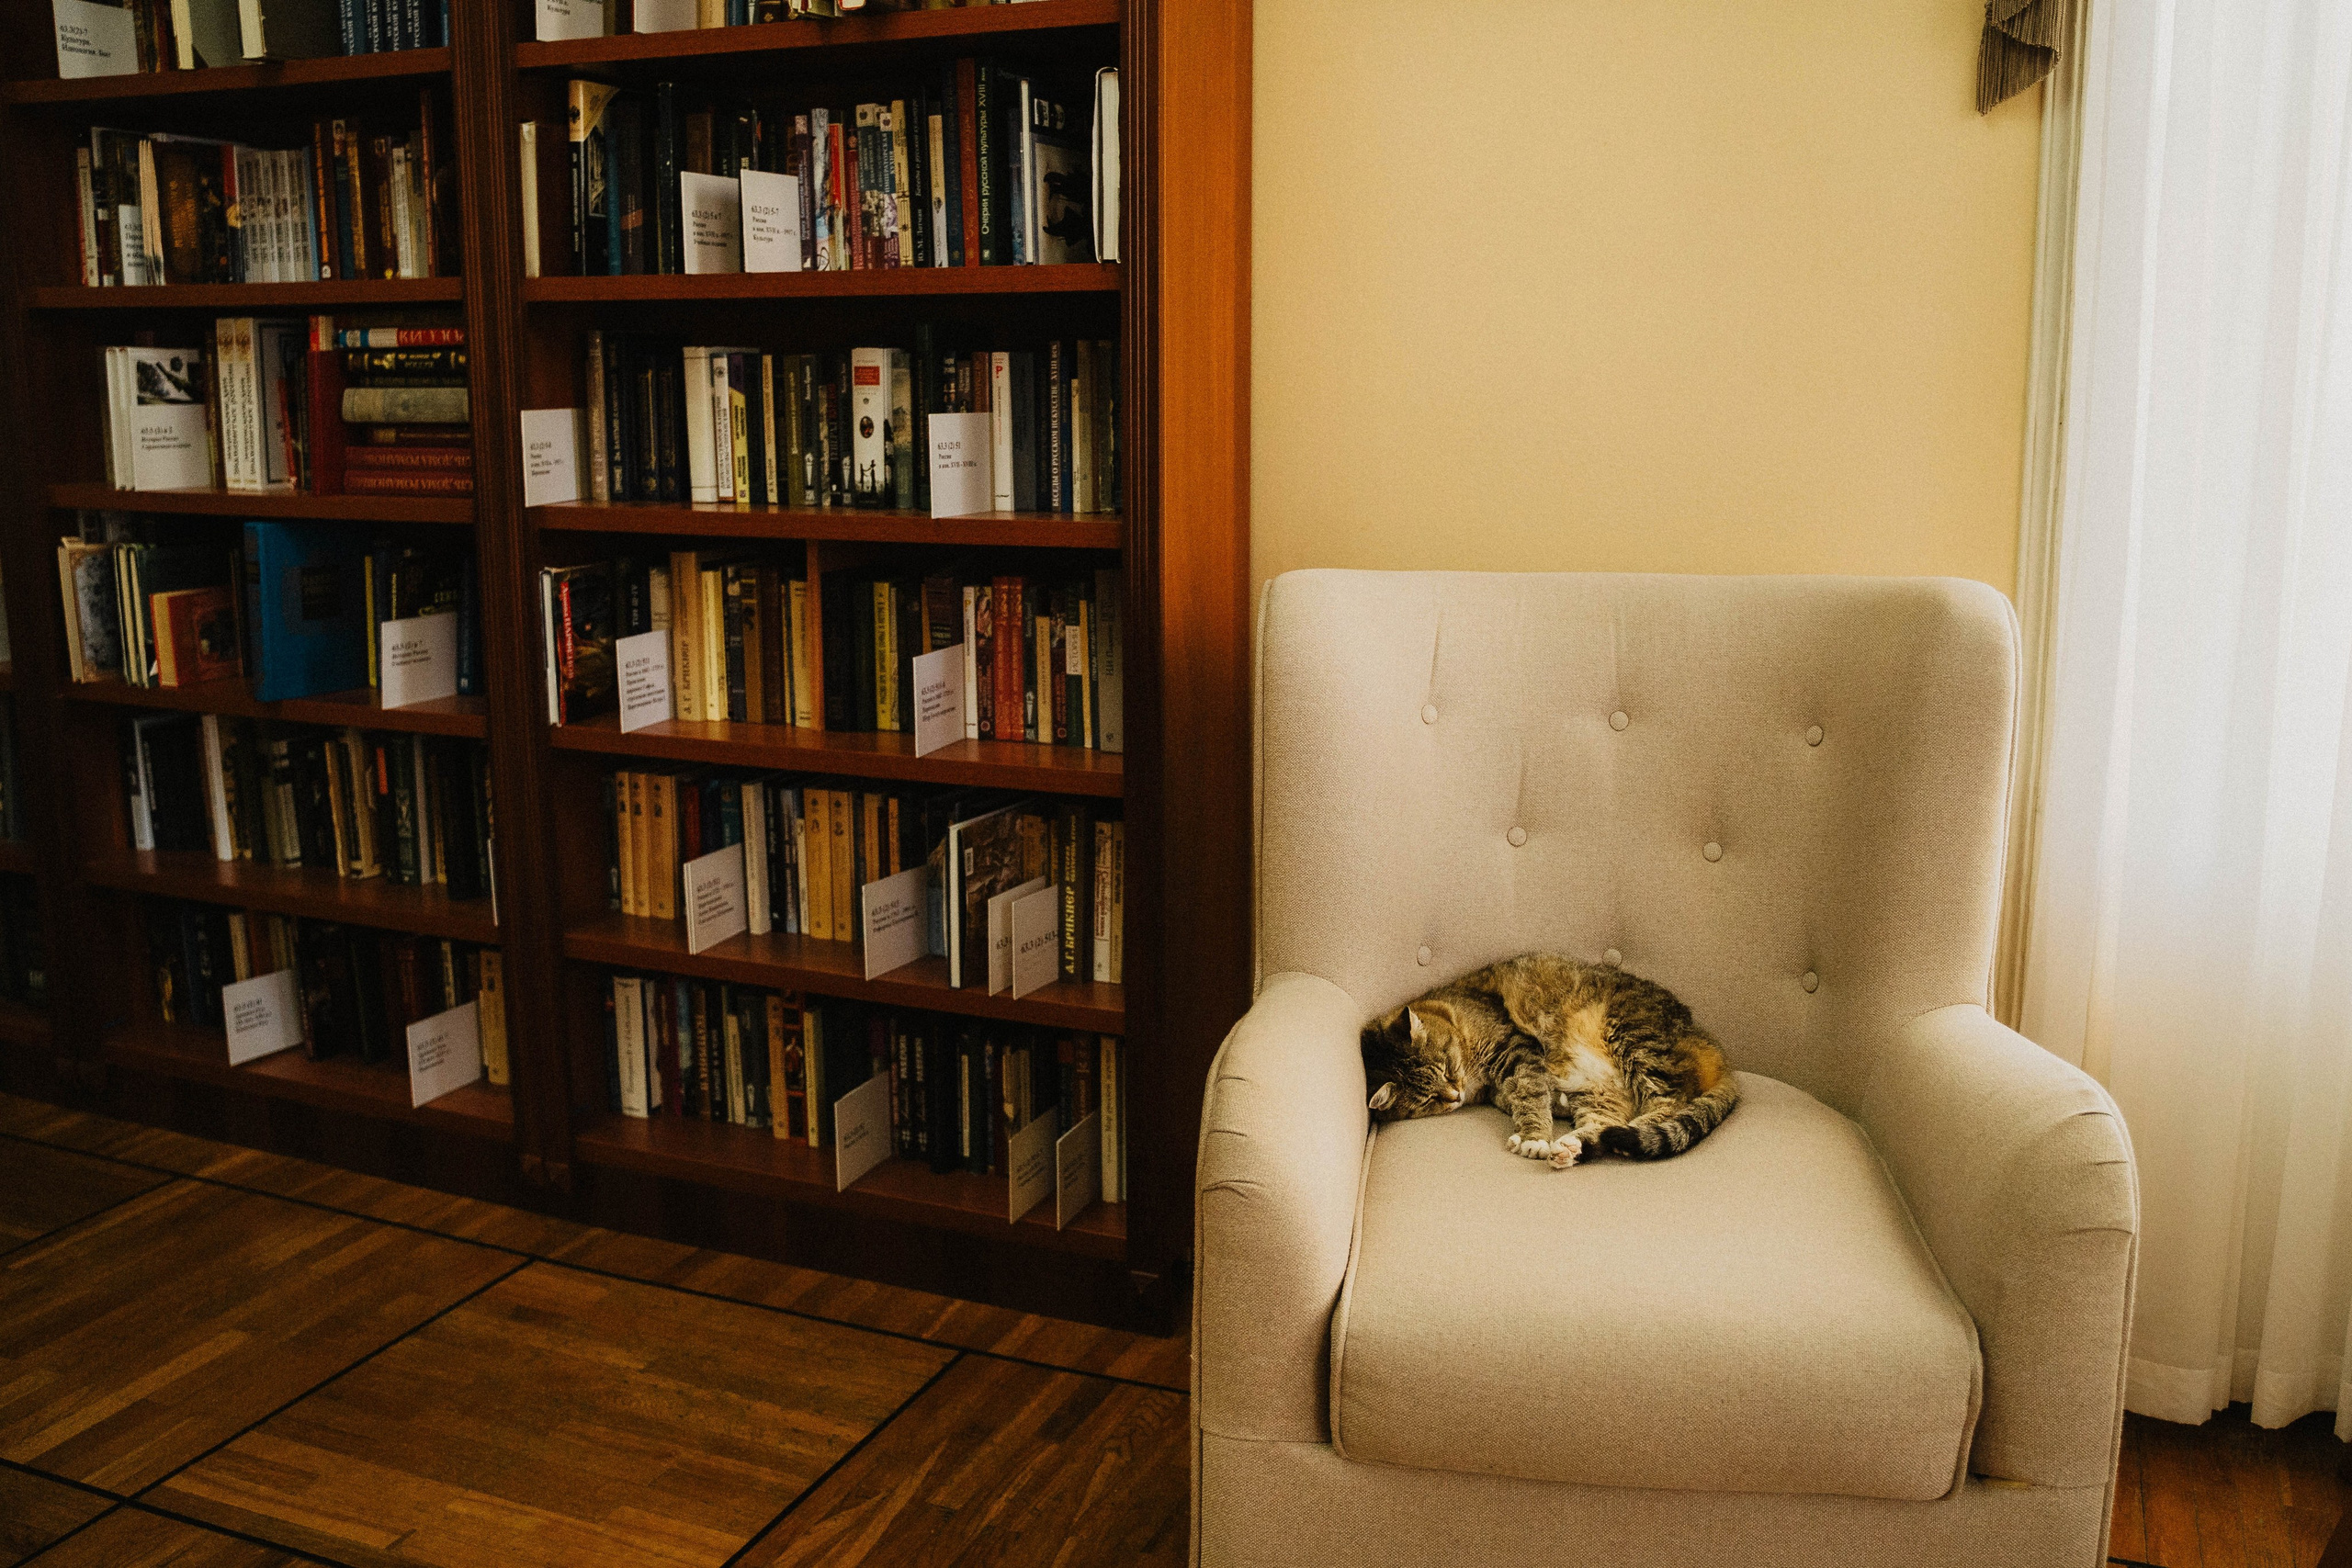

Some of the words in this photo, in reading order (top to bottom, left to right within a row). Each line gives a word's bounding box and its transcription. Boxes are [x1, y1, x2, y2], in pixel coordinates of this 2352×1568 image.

[371, 15, 379, 53] РУССКОЙ
[391, 13, 400, 51] РУССКОЙ
[978, 83, 986, 107] XVIII
[979, 109, 989, 154] культуры
[914, 169, 922, 197] Беседы
[980, 156, 989, 197] русской
[981, 197, 989, 235] Очерки
[1049, 358, 1057, 380] XVIII
[1049, 385, 1058, 429] ИСКУССТВЕ
[1050, 431, 1058, 467] РУССКОМ
[1050, 475, 1059, 507] БЕСЕДЫ
[681, 639, 691, 691] БРИКНЕР
[1020, 942, 1034, 954] 63.3
